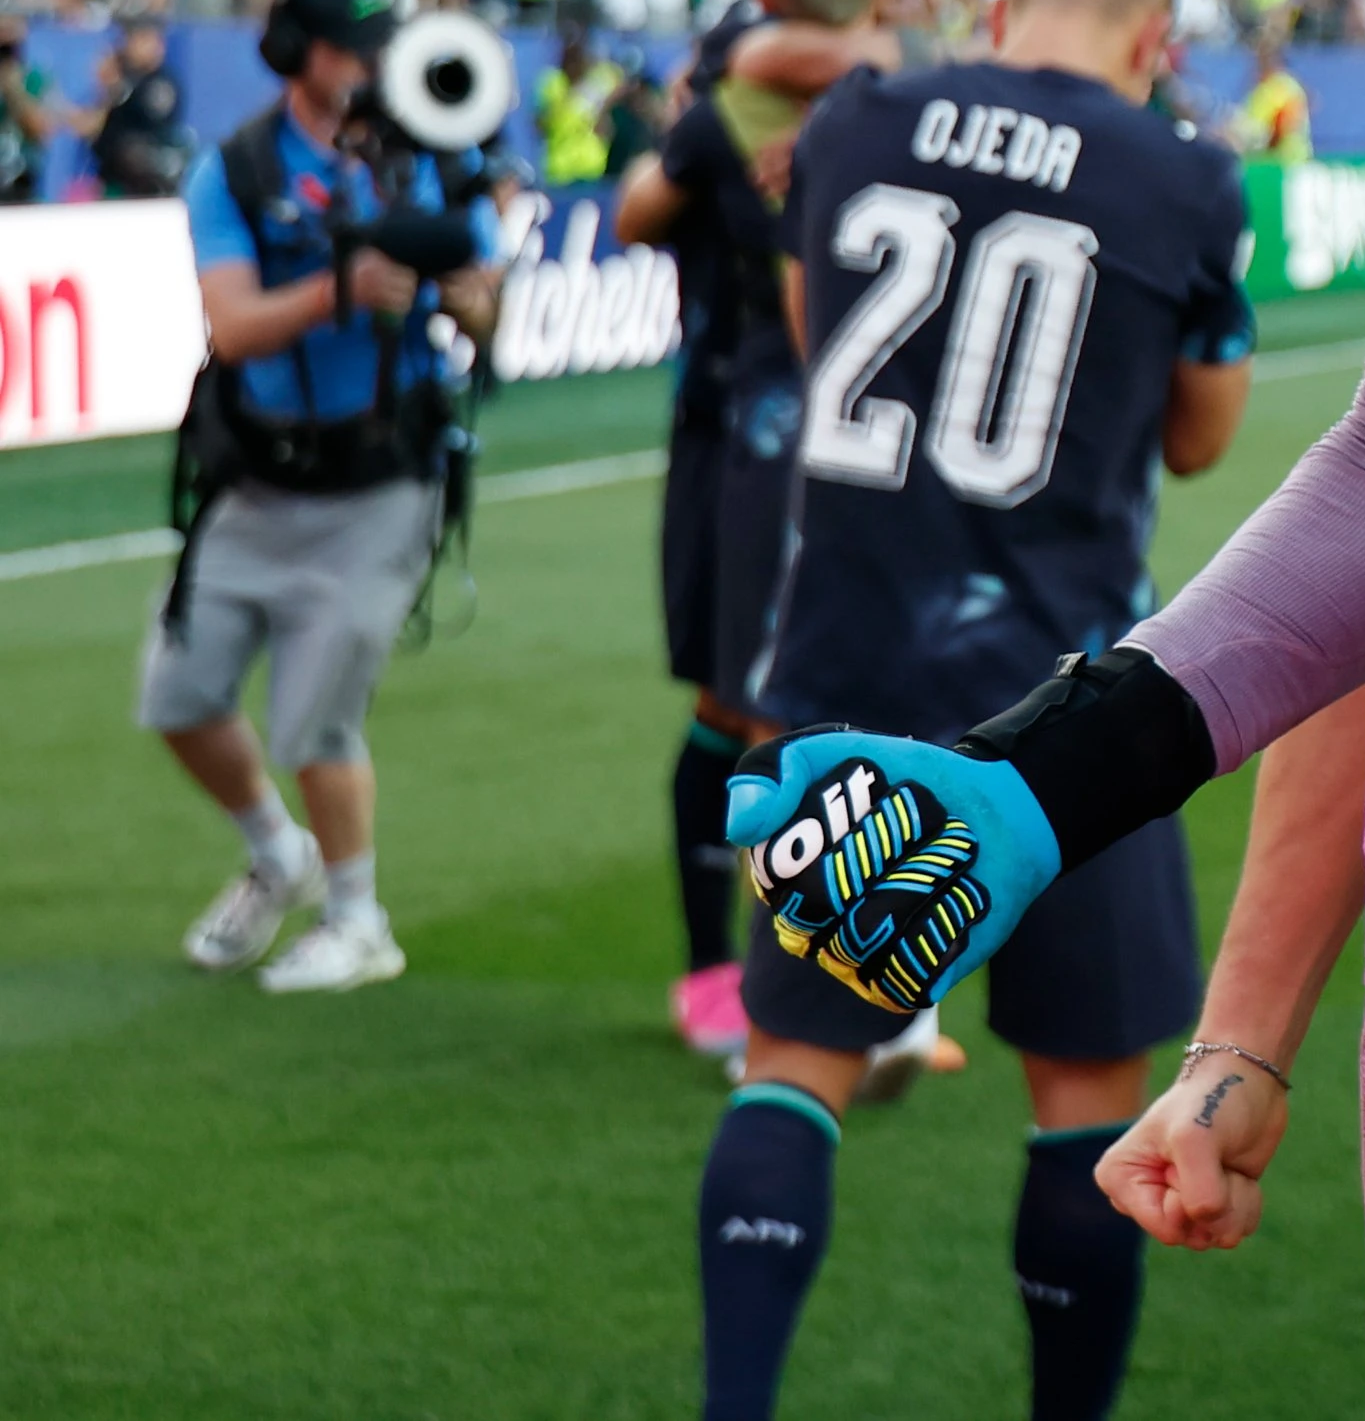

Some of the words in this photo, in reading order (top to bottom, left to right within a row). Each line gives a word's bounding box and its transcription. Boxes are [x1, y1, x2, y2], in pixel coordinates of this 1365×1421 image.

[911, 98, 1083, 194] OJEDA
[490, 190, 683, 383] ichelo
[801, 181, 1100, 511] 20
